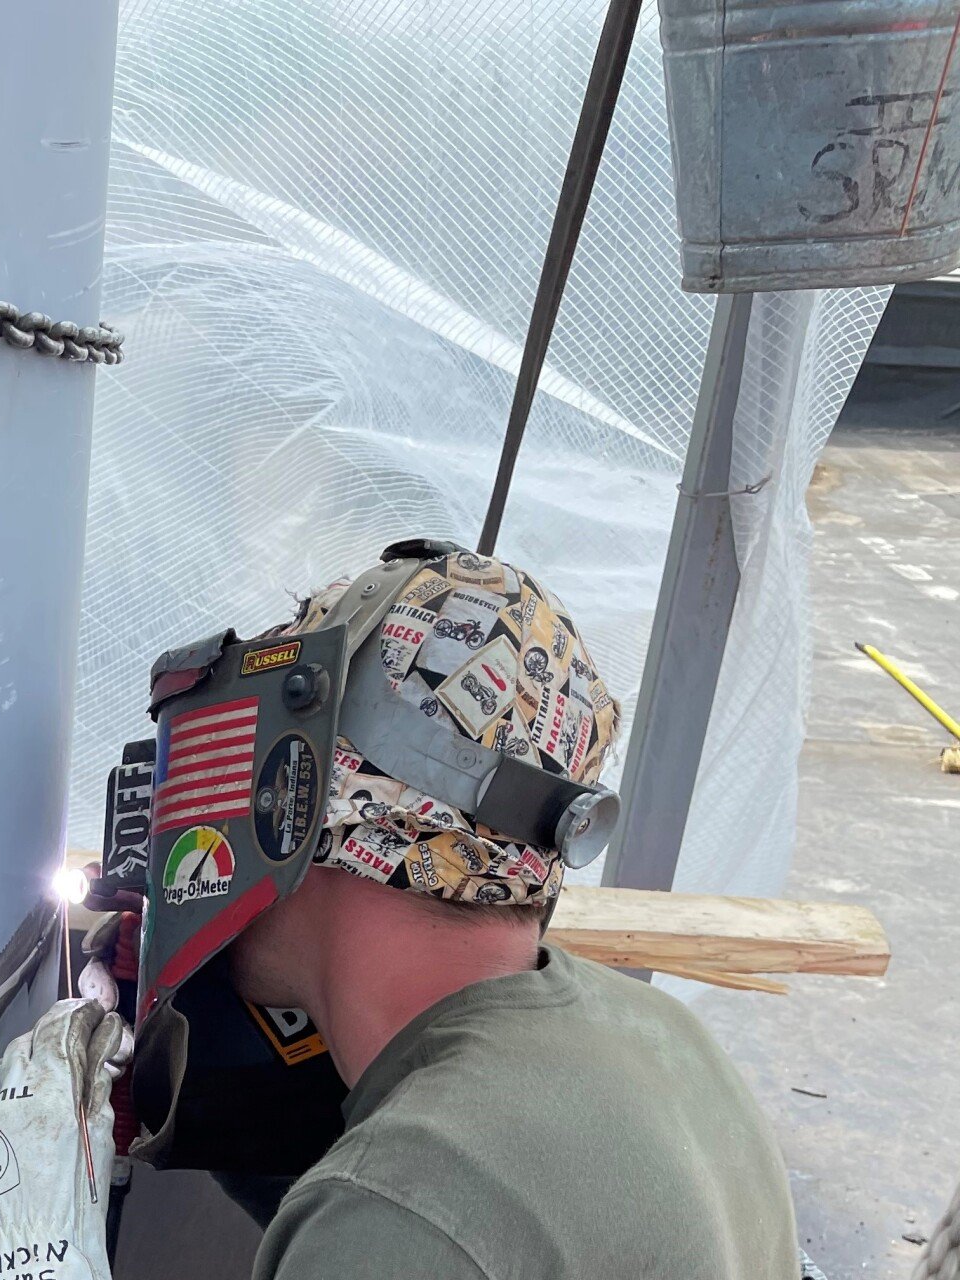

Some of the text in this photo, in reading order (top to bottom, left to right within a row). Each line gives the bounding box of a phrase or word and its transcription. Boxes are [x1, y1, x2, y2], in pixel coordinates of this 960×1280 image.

[531, 685, 551, 744] FLAT TRACK
[546, 694, 566, 754] RACES
[289, 760, 298, 792] Indiana
[334, 750, 360, 771] CES
[344, 838, 395, 876] RACES
[410, 860, 426, 887] OTOR
[418, 842, 438, 887] CYCLES
[163, 880, 231, 901] Drag-O-Meter
